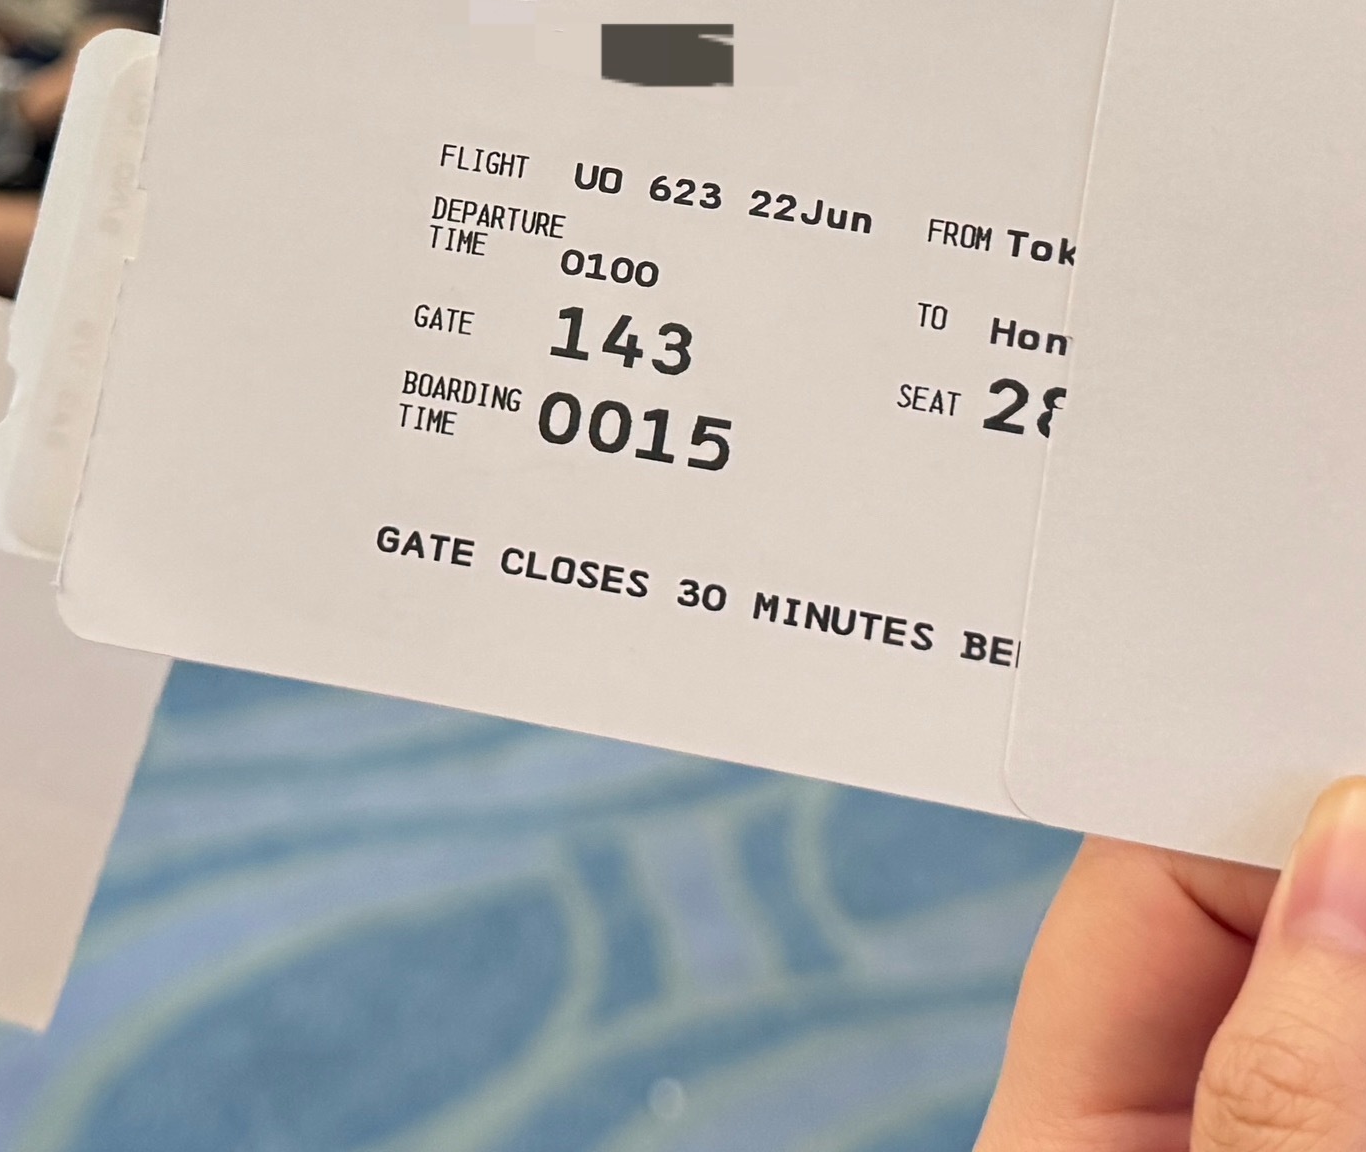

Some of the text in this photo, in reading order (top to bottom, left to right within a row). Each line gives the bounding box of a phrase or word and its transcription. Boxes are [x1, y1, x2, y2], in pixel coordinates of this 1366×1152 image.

[440, 143, 872, 234] FLIGHT UO 623 22Jun
[429, 195, 567, 241] DEPARTURE
[429, 224, 489, 257] TIME
[927, 218, 1077, 267] FROM Tok
[560, 248, 660, 288] 0100
[414, 304, 693, 376] GATE 143
[917, 302, 1068, 357] TO Hon
[401, 369, 523, 413] BOARDING
[896, 383, 962, 417] SEAT
[399, 402, 458, 436] TIME
[538, 391, 733, 472] 0015
[376, 525, 1022, 669] GATE CLOSES 30 MINUTES BE
